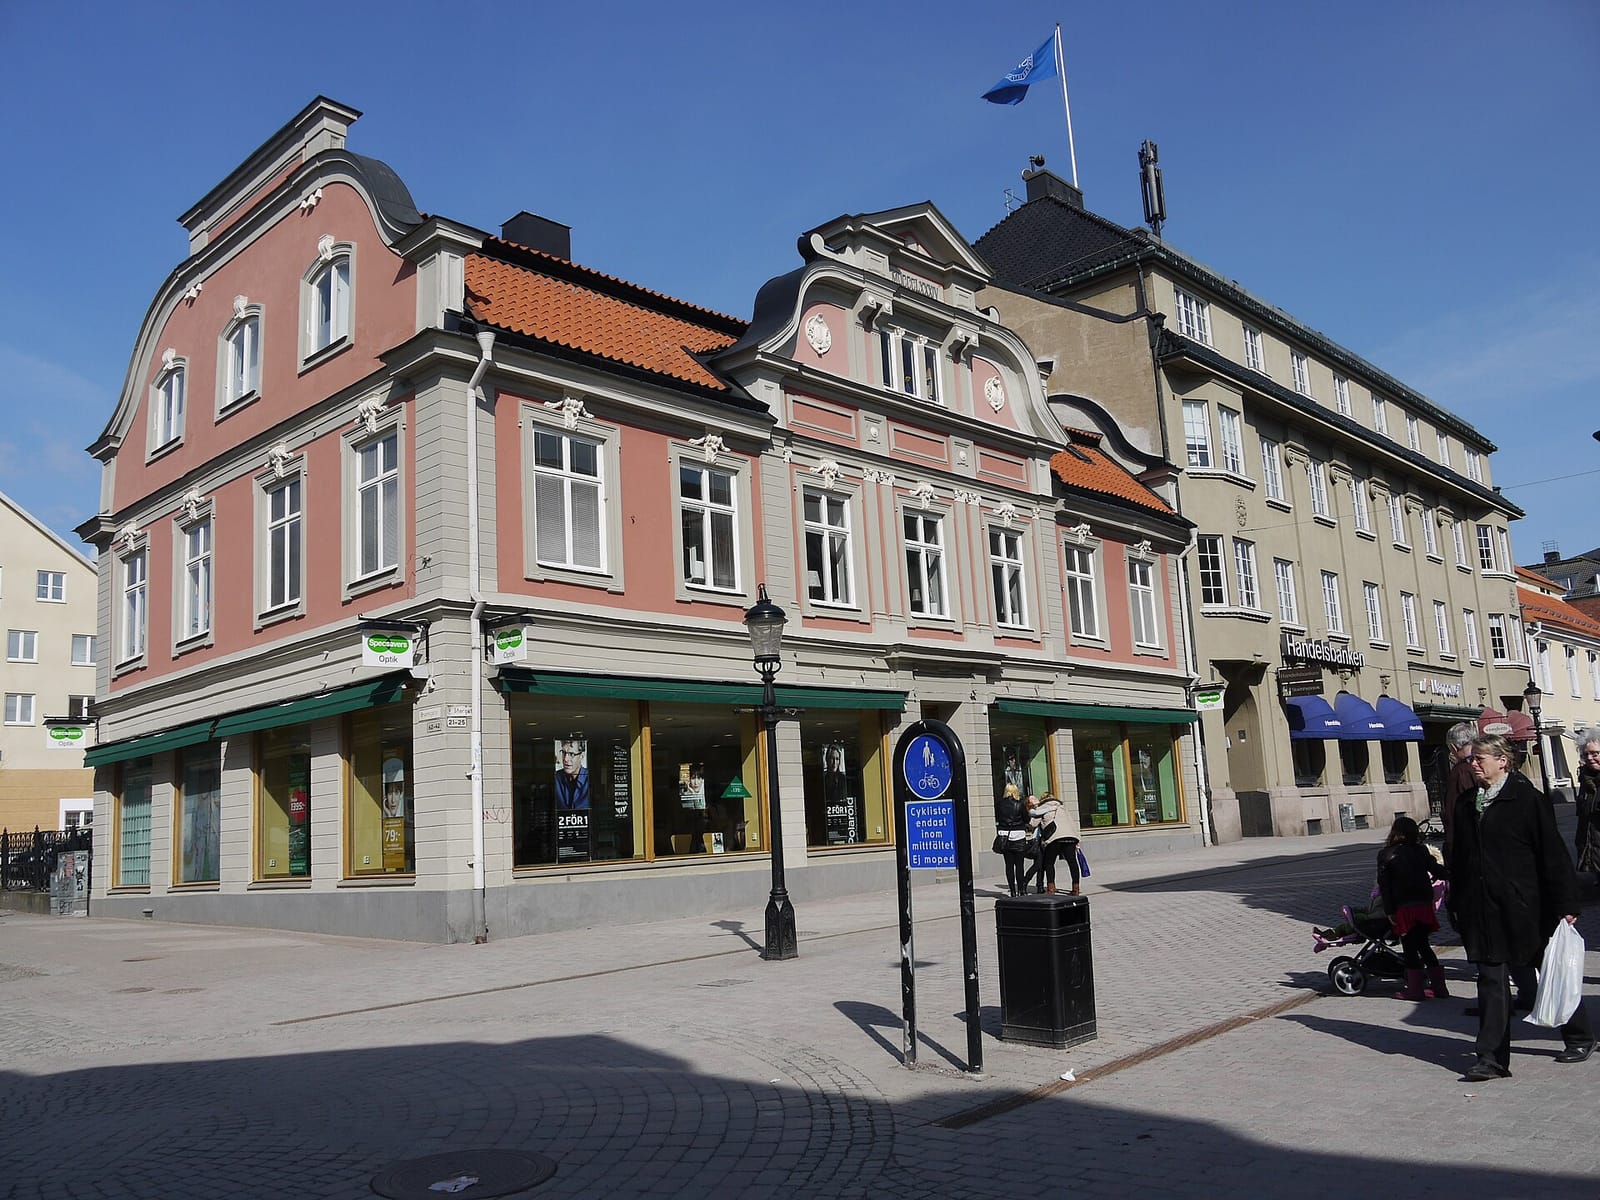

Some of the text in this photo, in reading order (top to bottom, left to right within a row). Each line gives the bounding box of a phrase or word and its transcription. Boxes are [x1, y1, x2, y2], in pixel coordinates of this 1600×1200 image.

[369, 638, 408, 648] Specsavers
[1285, 634, 1366, 667] Handelsbanken
[378, 654, 398, 664] Optik
[827, 804, 848, 815] 2 FÖR 1
[910, 806, 951, 818] Cyklister
[558, 813, 588, 826] 2 FÖR 1
[846, 797, 856, 845] Polaroid
[916, 818, 947, 828] endast
[921, 829, 943, 839] inom
[912, 840, 954, 850] mittfältet
[912, 853, 955, 866] Ej moped
